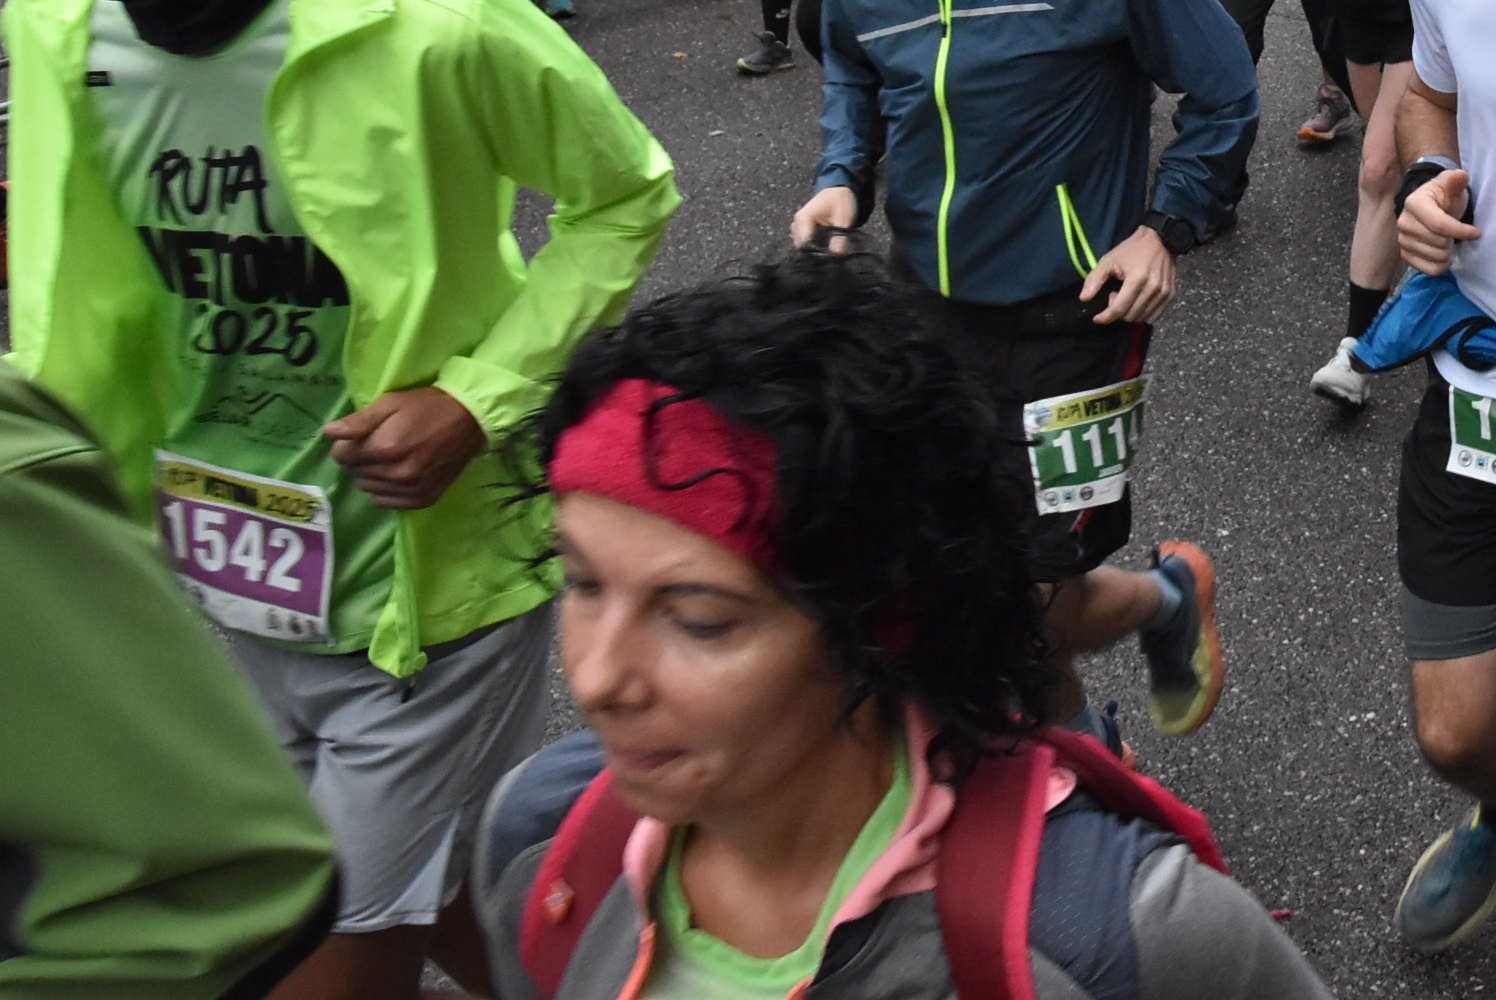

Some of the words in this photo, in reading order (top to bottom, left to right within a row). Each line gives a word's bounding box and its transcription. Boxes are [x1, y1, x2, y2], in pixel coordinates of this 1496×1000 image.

[148, 144, 274, 234] RUTA
[136, 225, 351, 309] VETONA
[162, 500, 305, 593] 1542
